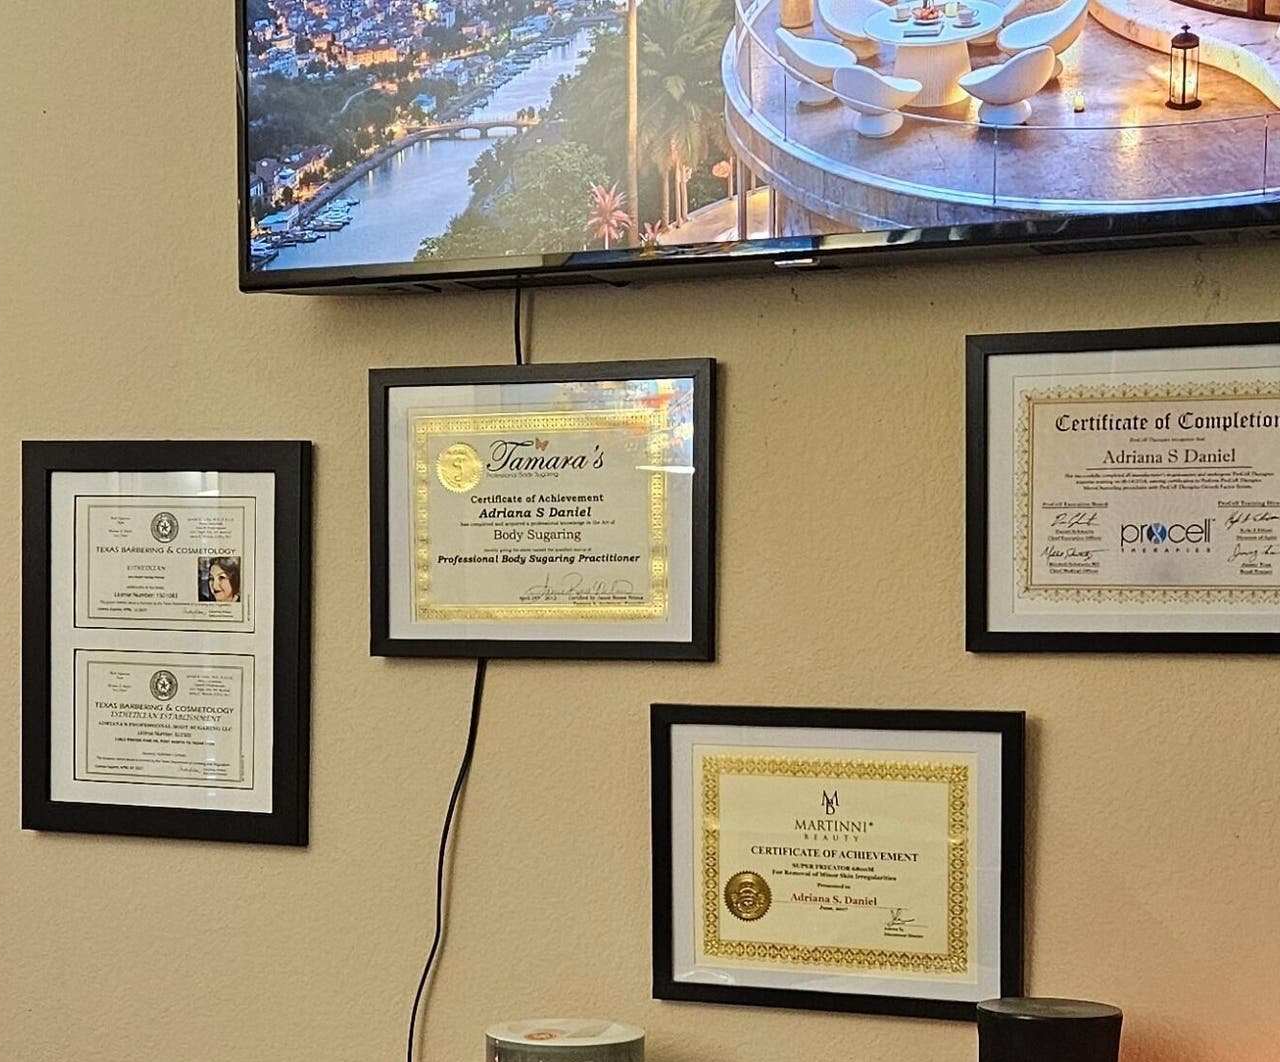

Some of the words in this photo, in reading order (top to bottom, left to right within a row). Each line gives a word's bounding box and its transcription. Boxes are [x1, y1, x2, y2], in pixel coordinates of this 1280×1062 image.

[1055, 414, 1149, 432] Certificate
[1154, 413, 1171, 430] of
[486, 439, 605, 472] Tamara's
[1102, 450, 1163, 464] Adriana
[1168, 450, 1178, 464] S
[1184, 448, 1236, 463] Daniel
[470, 494, 523, 504] Certificate
[526, 495, 536, 504] of
[538, 493, 604, 503] Achievement
[479, 507, 531, 519] Adriana
[536, 508, 544, 518] S
[549, 507, 591, 518] Daniel
[494, 530, 523, 543] Body
[527, 529, 582, 543] Sugaring
[166, 546, 174, 554] &
[438, 555, 499, 564] Professional
[501, 555, 526, 565] Body
[529, 554, 575, 565] Sugaring
[578, 554, 641, 563] Practitioner
[120, 703, 163, 711] BARBERING
[175, 705, 234, 714] COSMETOLOGY
[794, 819, 869, 833] MARTINNI
[804, 834, 859, 842] BEAUTY
[751, 846, 820, 858] CERTIFICATE
[823, 849, 837, 858] OF
[839, 850, 919, 862] ACHIEVEMENT
[790, 893, 830, 904] Adriana
[832, 895, 842, 904] S.
[845, 896, 877, 906] Daniel
